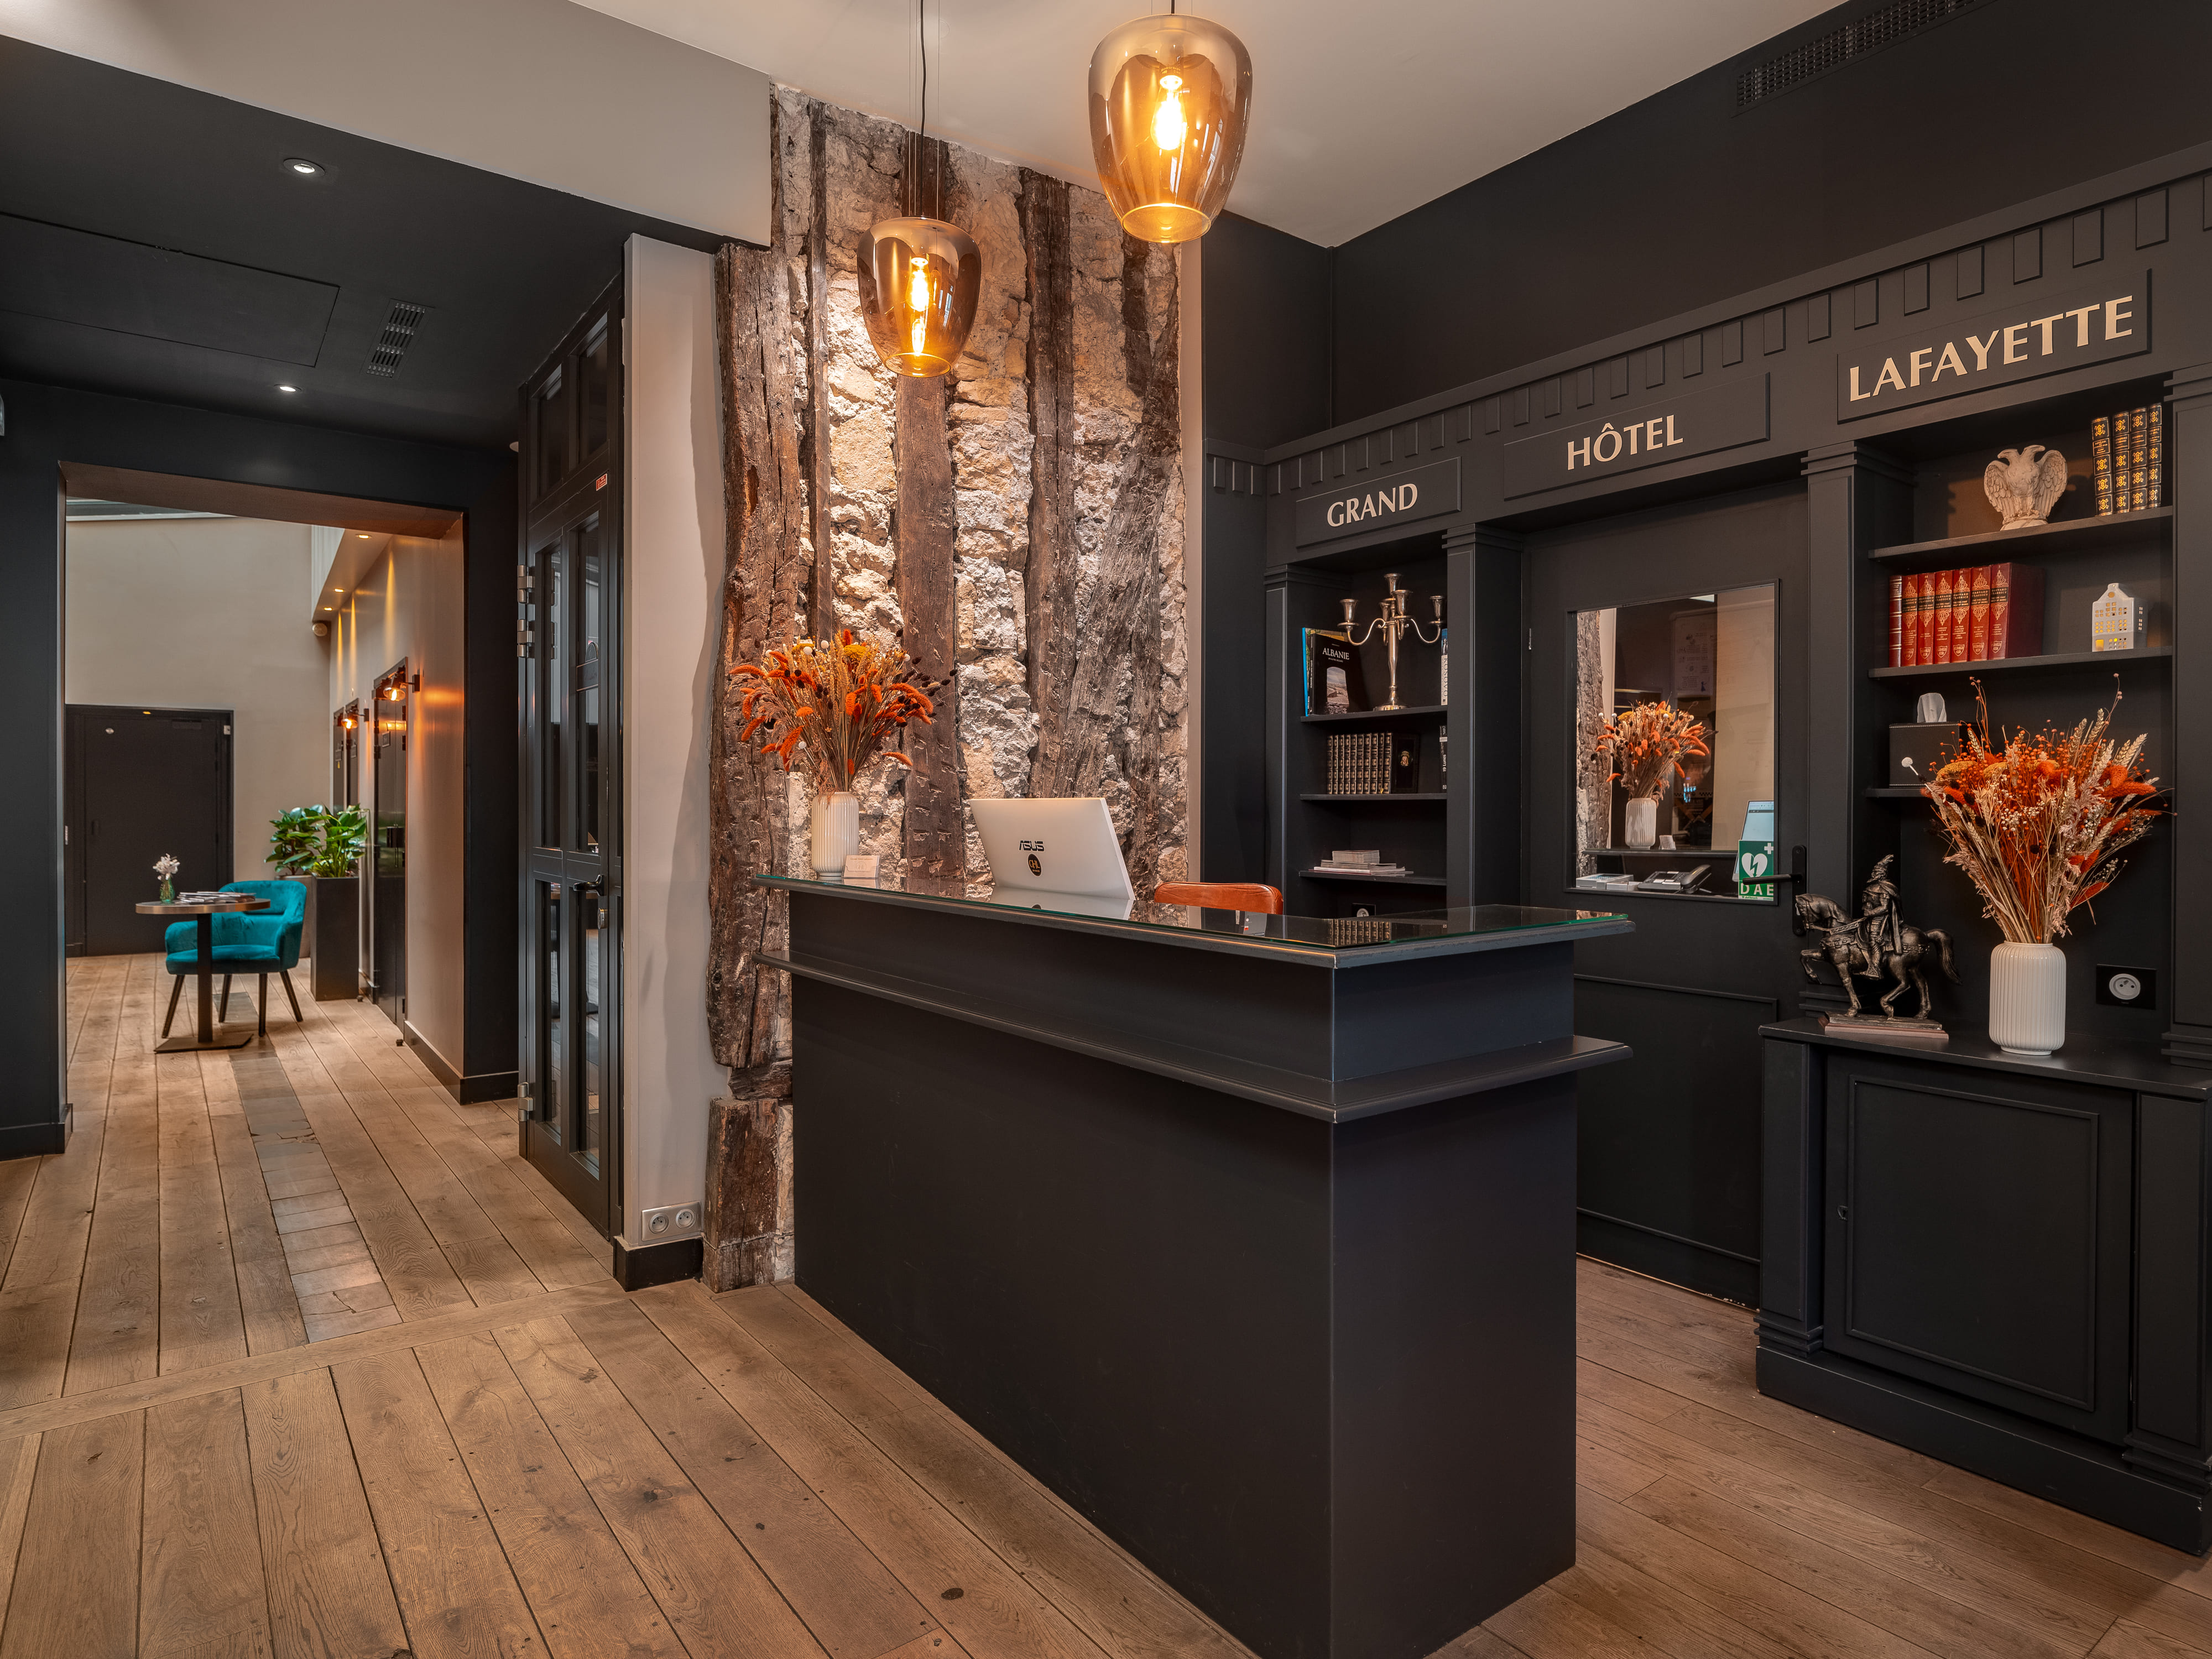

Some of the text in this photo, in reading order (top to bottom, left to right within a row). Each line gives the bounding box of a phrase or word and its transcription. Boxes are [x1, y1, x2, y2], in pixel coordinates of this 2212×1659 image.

[1850, 296, 2132, 401] LAFAYETTE
[1568, 415, 1683, 470] HÔTEL
[1328, 484, 1417, 526] GRAND
[1323, 647, 1350, 660] ALBANIE
[1019, 840, 1045, 852] ASUS
[1741, 883, 1774, 896] DAE
